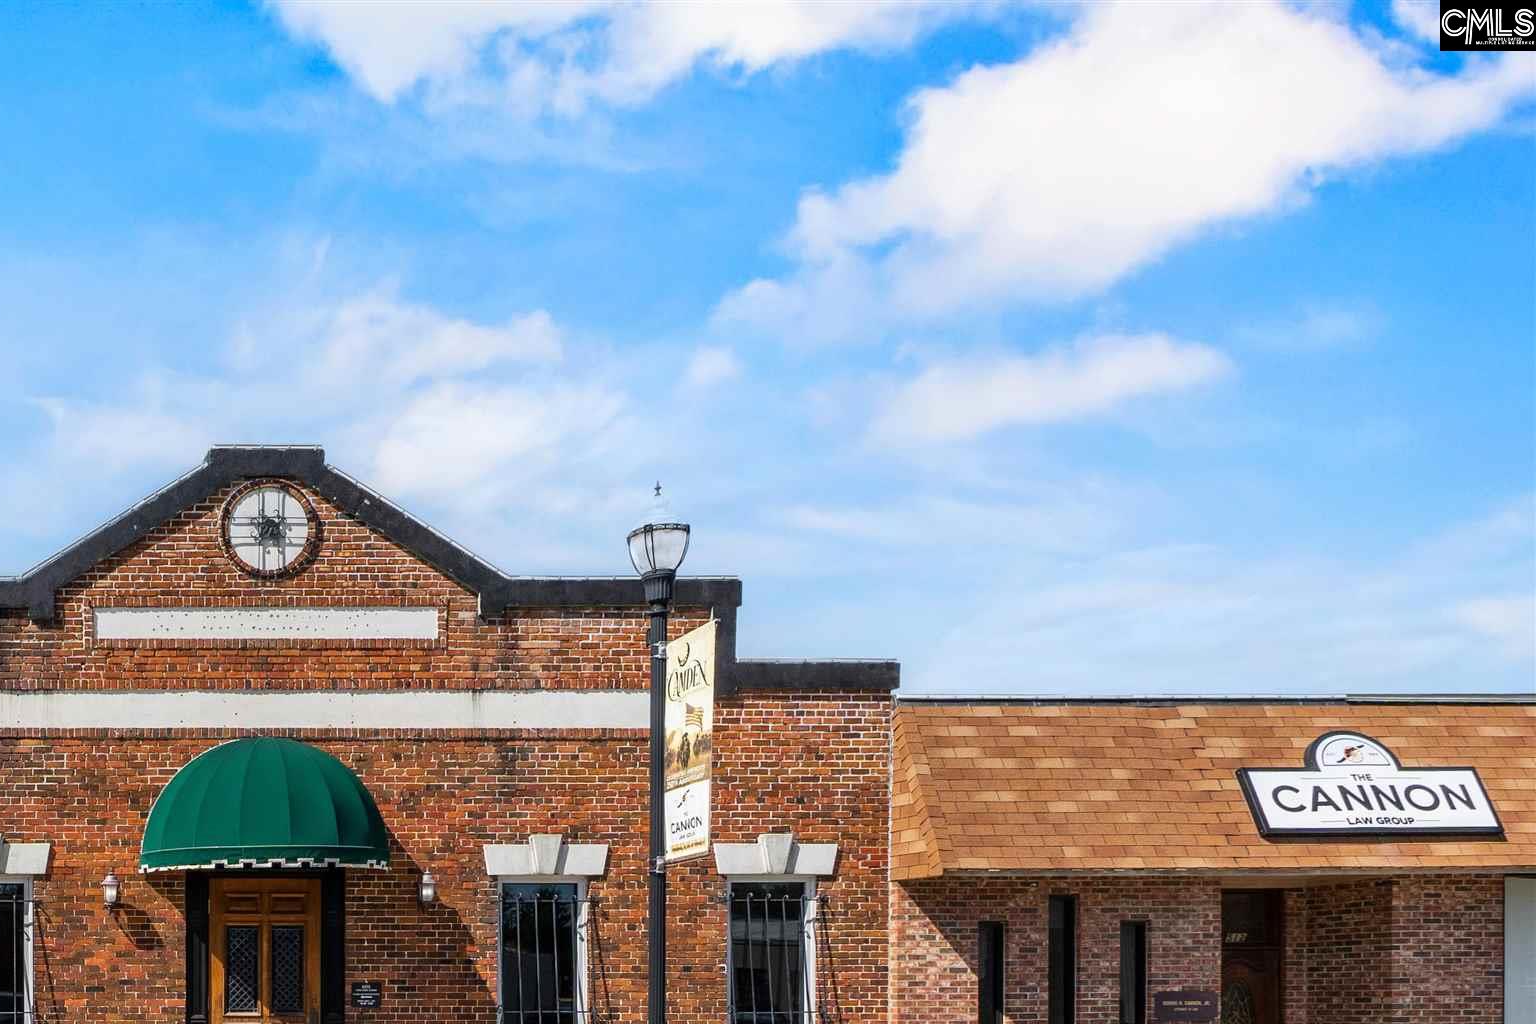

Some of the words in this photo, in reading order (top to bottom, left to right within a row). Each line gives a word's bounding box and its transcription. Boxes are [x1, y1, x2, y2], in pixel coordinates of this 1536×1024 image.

[1350, 773, 1374, 781] THE
[1272, 784, 1477, 812] CANNON
[1346, 817, 1373, 825] LAW
[1376, 816, 1415, 825] GROUP
